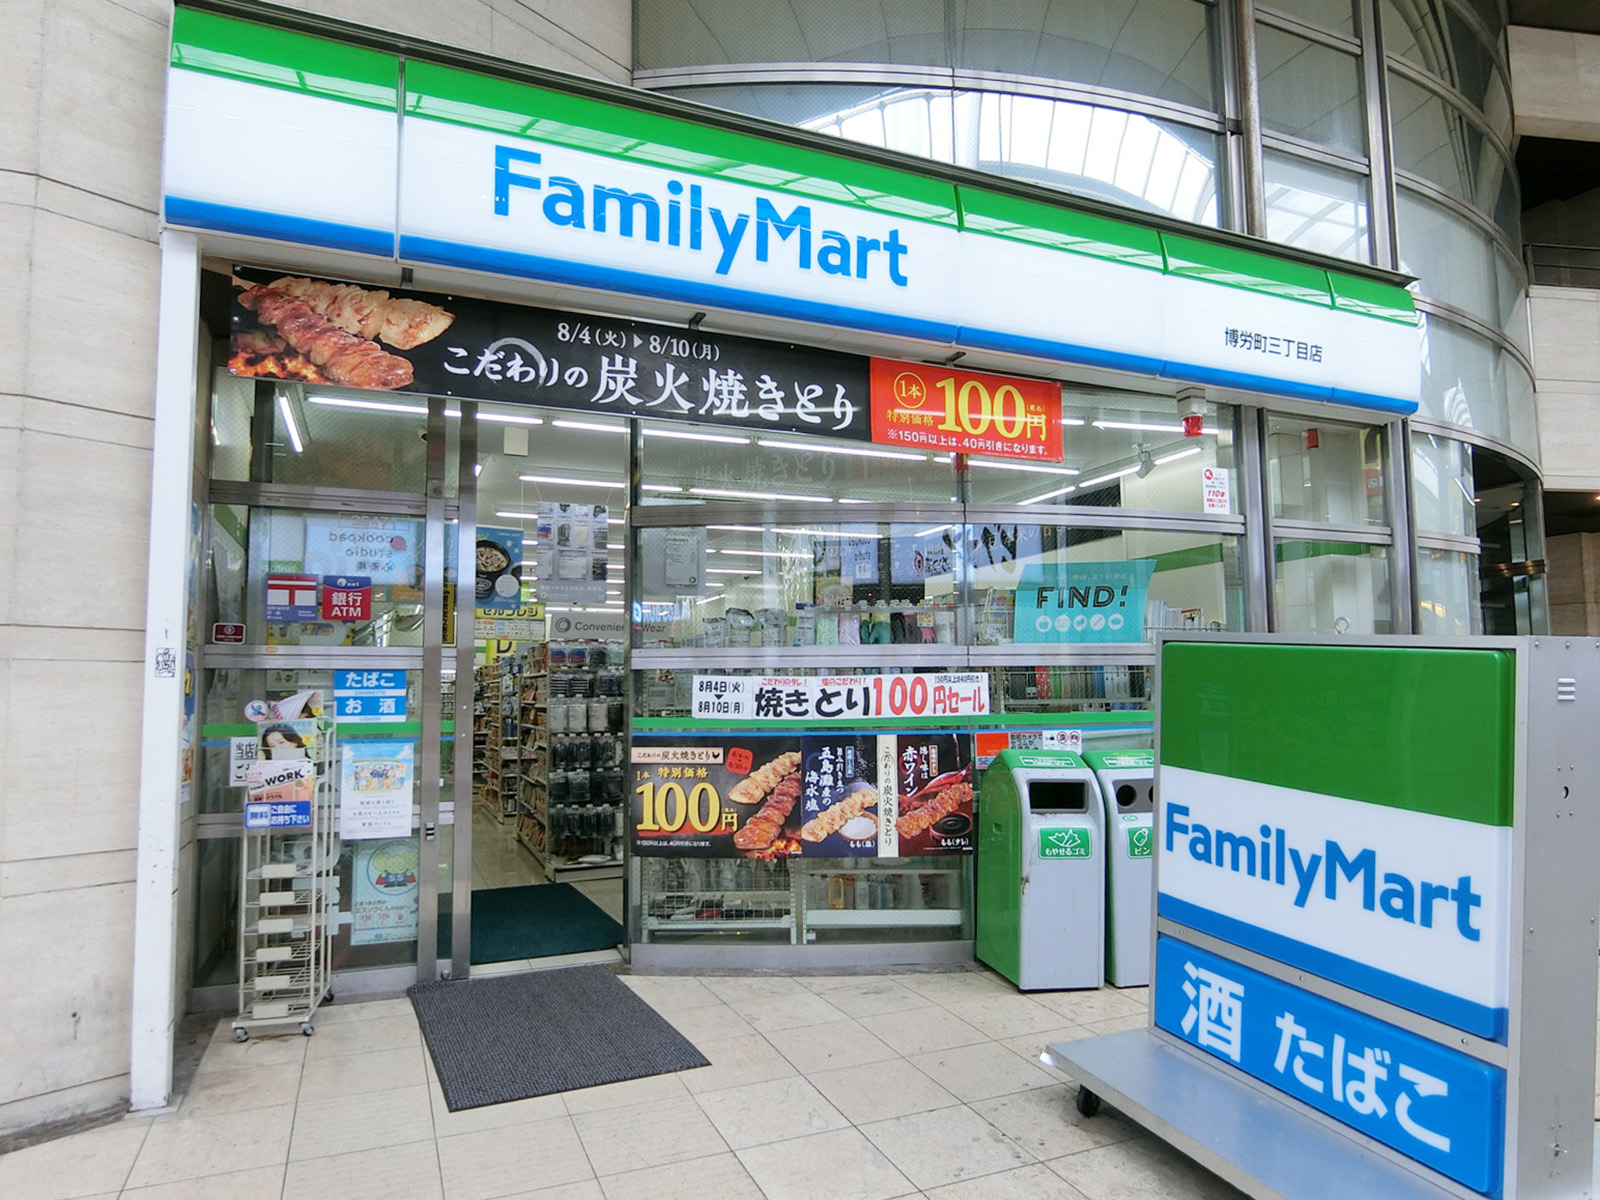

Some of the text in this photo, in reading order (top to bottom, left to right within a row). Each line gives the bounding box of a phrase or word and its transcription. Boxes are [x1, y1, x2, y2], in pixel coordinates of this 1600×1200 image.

[494, 145, 908, 287] FamilyMart
[557, 322, 720, 362] 8/4(火) 8/10(月)
[1225, 327, 1323, 363] 博労町三丁目店
[899, 380, 922, 399] 1本
[886, 408, 935, 427] 特別価格
[332, 592, 363, 606] 銀行
[1036, 585, 1129, 609] FIND!
[331, 607, 361, 617] ATM
[345, 671, 395, 688] たばこ
[699, 680, 745, 693] 8月4日(火)
[698, 701, 745, 714] 8月10日(月)
[265, 769, 306, 786] WORK
[636, 766, 709, 781] 1本 特別価格
[902, 746, 919, 797] 赤ワイン
[804, 771, 820, 812] 海水塩
[1045, 847, 1086, 856] もやせるゴミ
[1165, 801, 1482, 942] FamilyMart
[1181, 960, 1451, 1154] 酒 たばこ
